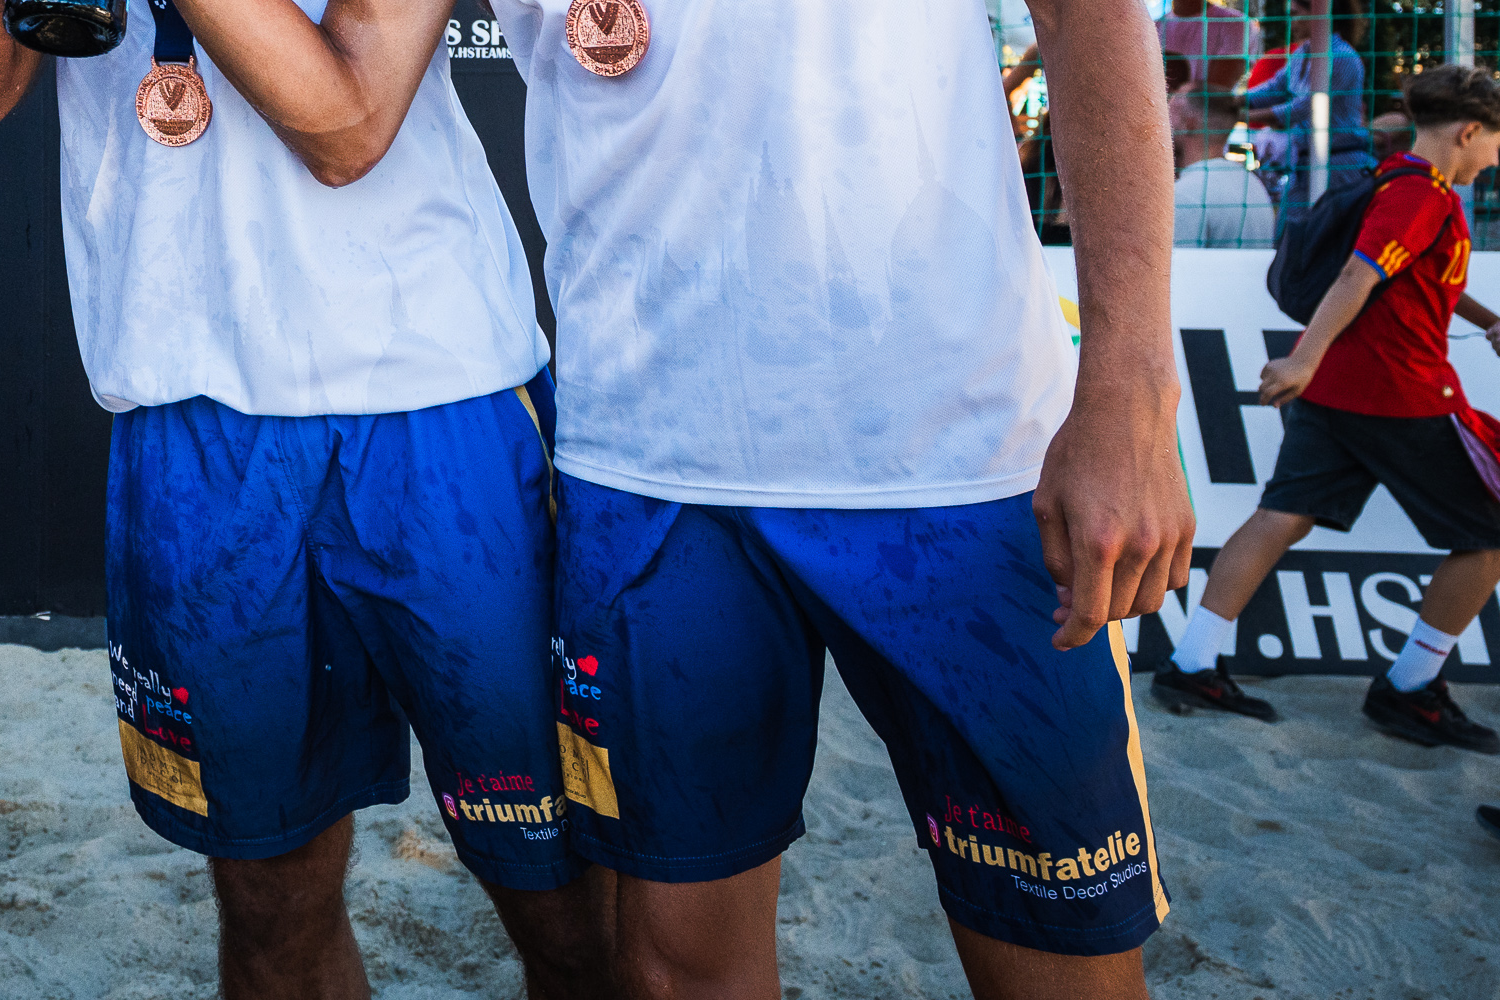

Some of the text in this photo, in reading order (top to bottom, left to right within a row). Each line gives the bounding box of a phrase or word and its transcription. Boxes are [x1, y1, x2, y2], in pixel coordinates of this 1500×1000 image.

[1441, 237, 1471, 286] 10
[109, 640, 172, 706] We really
[564, 678, 602, 701] ace
[111, 671, 193, 725] need peace
[114, 695, 192, 752] and Love
[455, 771, 476, 797] Je
[460, 794, 568, 824] triumfa
[944, 794, 964, 825] Je
[519, 826, 559, 841] Textile
[943, 829, 1142, 882] triumfatelie
[1010, 860, 1148, 901] Textile Decor Studios
